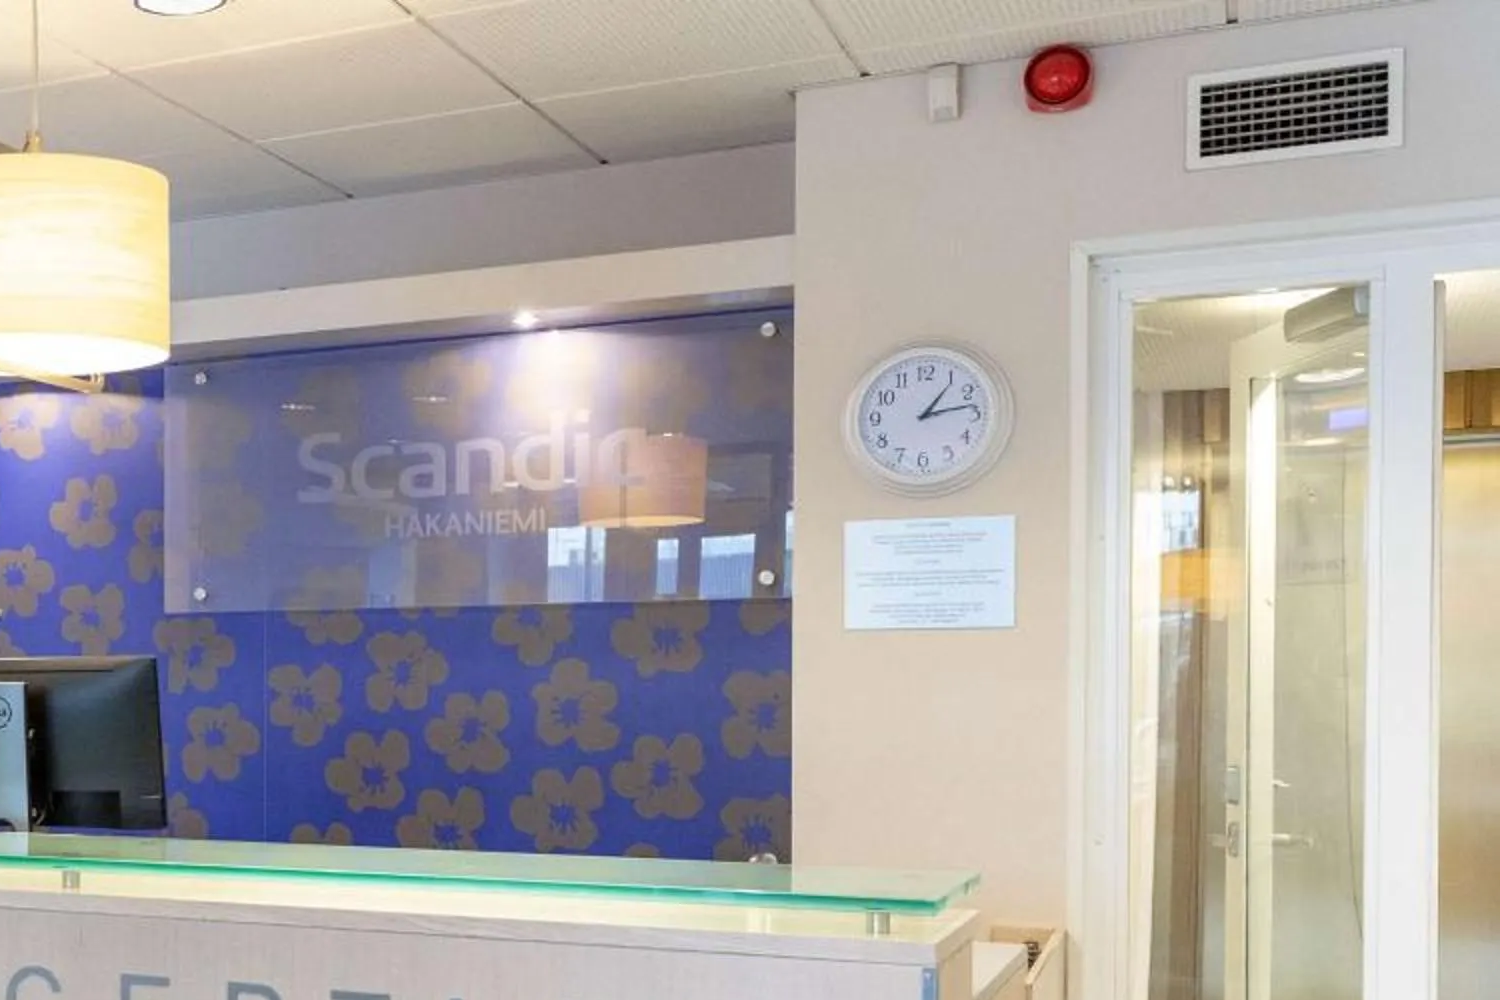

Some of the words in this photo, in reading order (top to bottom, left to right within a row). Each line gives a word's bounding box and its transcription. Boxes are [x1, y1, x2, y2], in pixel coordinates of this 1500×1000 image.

[896, 372, 907, 389] 11
[916, 364, 935, 382] 12
[948, 370, 954, 385] 1
[878, 389, 895, 407] 10
[962, 384, 974, 401] 2
[869, 411, 881, 427] 9
[876, 433, 888, 449] 8
[961, 428, 970, 445] 4
[296, 408, 646, 500] Scandic
[894, 447, 906, 464] 7
[917, 451, 929, 468] 6
[385, 506, 547, 539] HAKANIEMI
